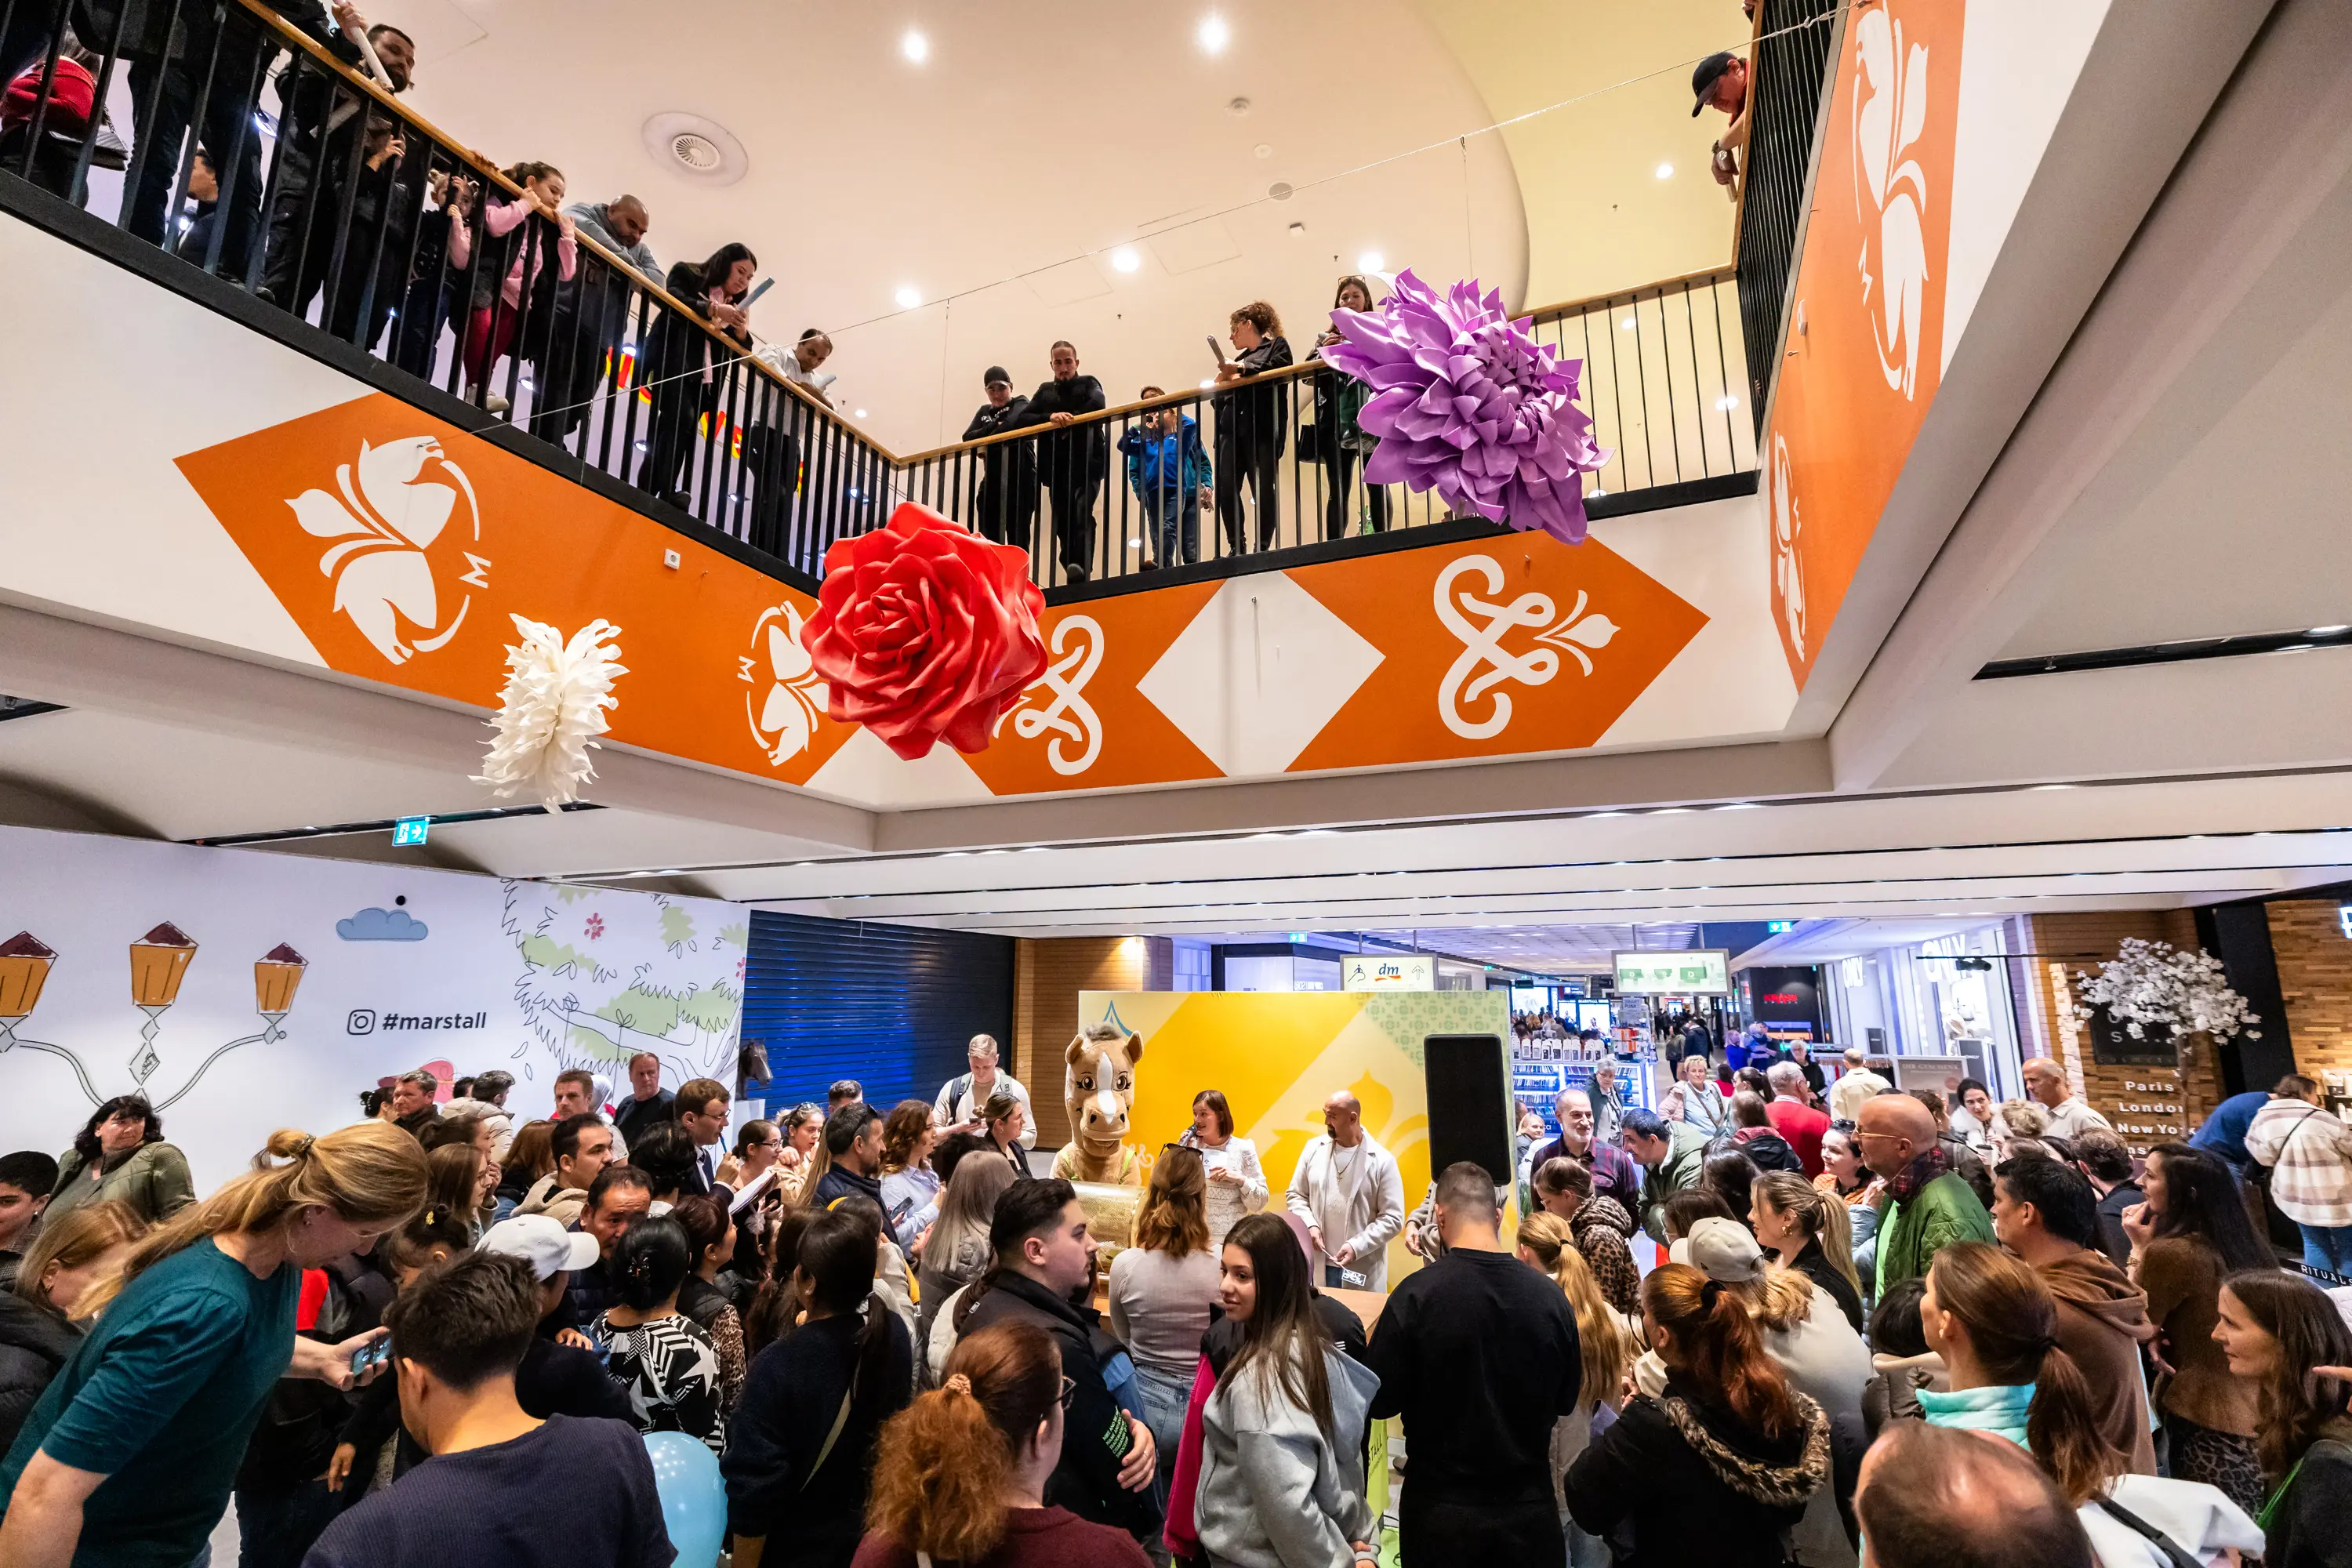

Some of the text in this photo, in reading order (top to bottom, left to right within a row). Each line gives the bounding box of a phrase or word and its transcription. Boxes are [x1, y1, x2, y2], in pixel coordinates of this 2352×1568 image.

[1378, 963, 1399, 975] dm
[382, 1011, 487, 1030] #marstall
[2125, 1081, 2175, 1092] Paris
[2118, 1123, 2196, 1135] New Yok
